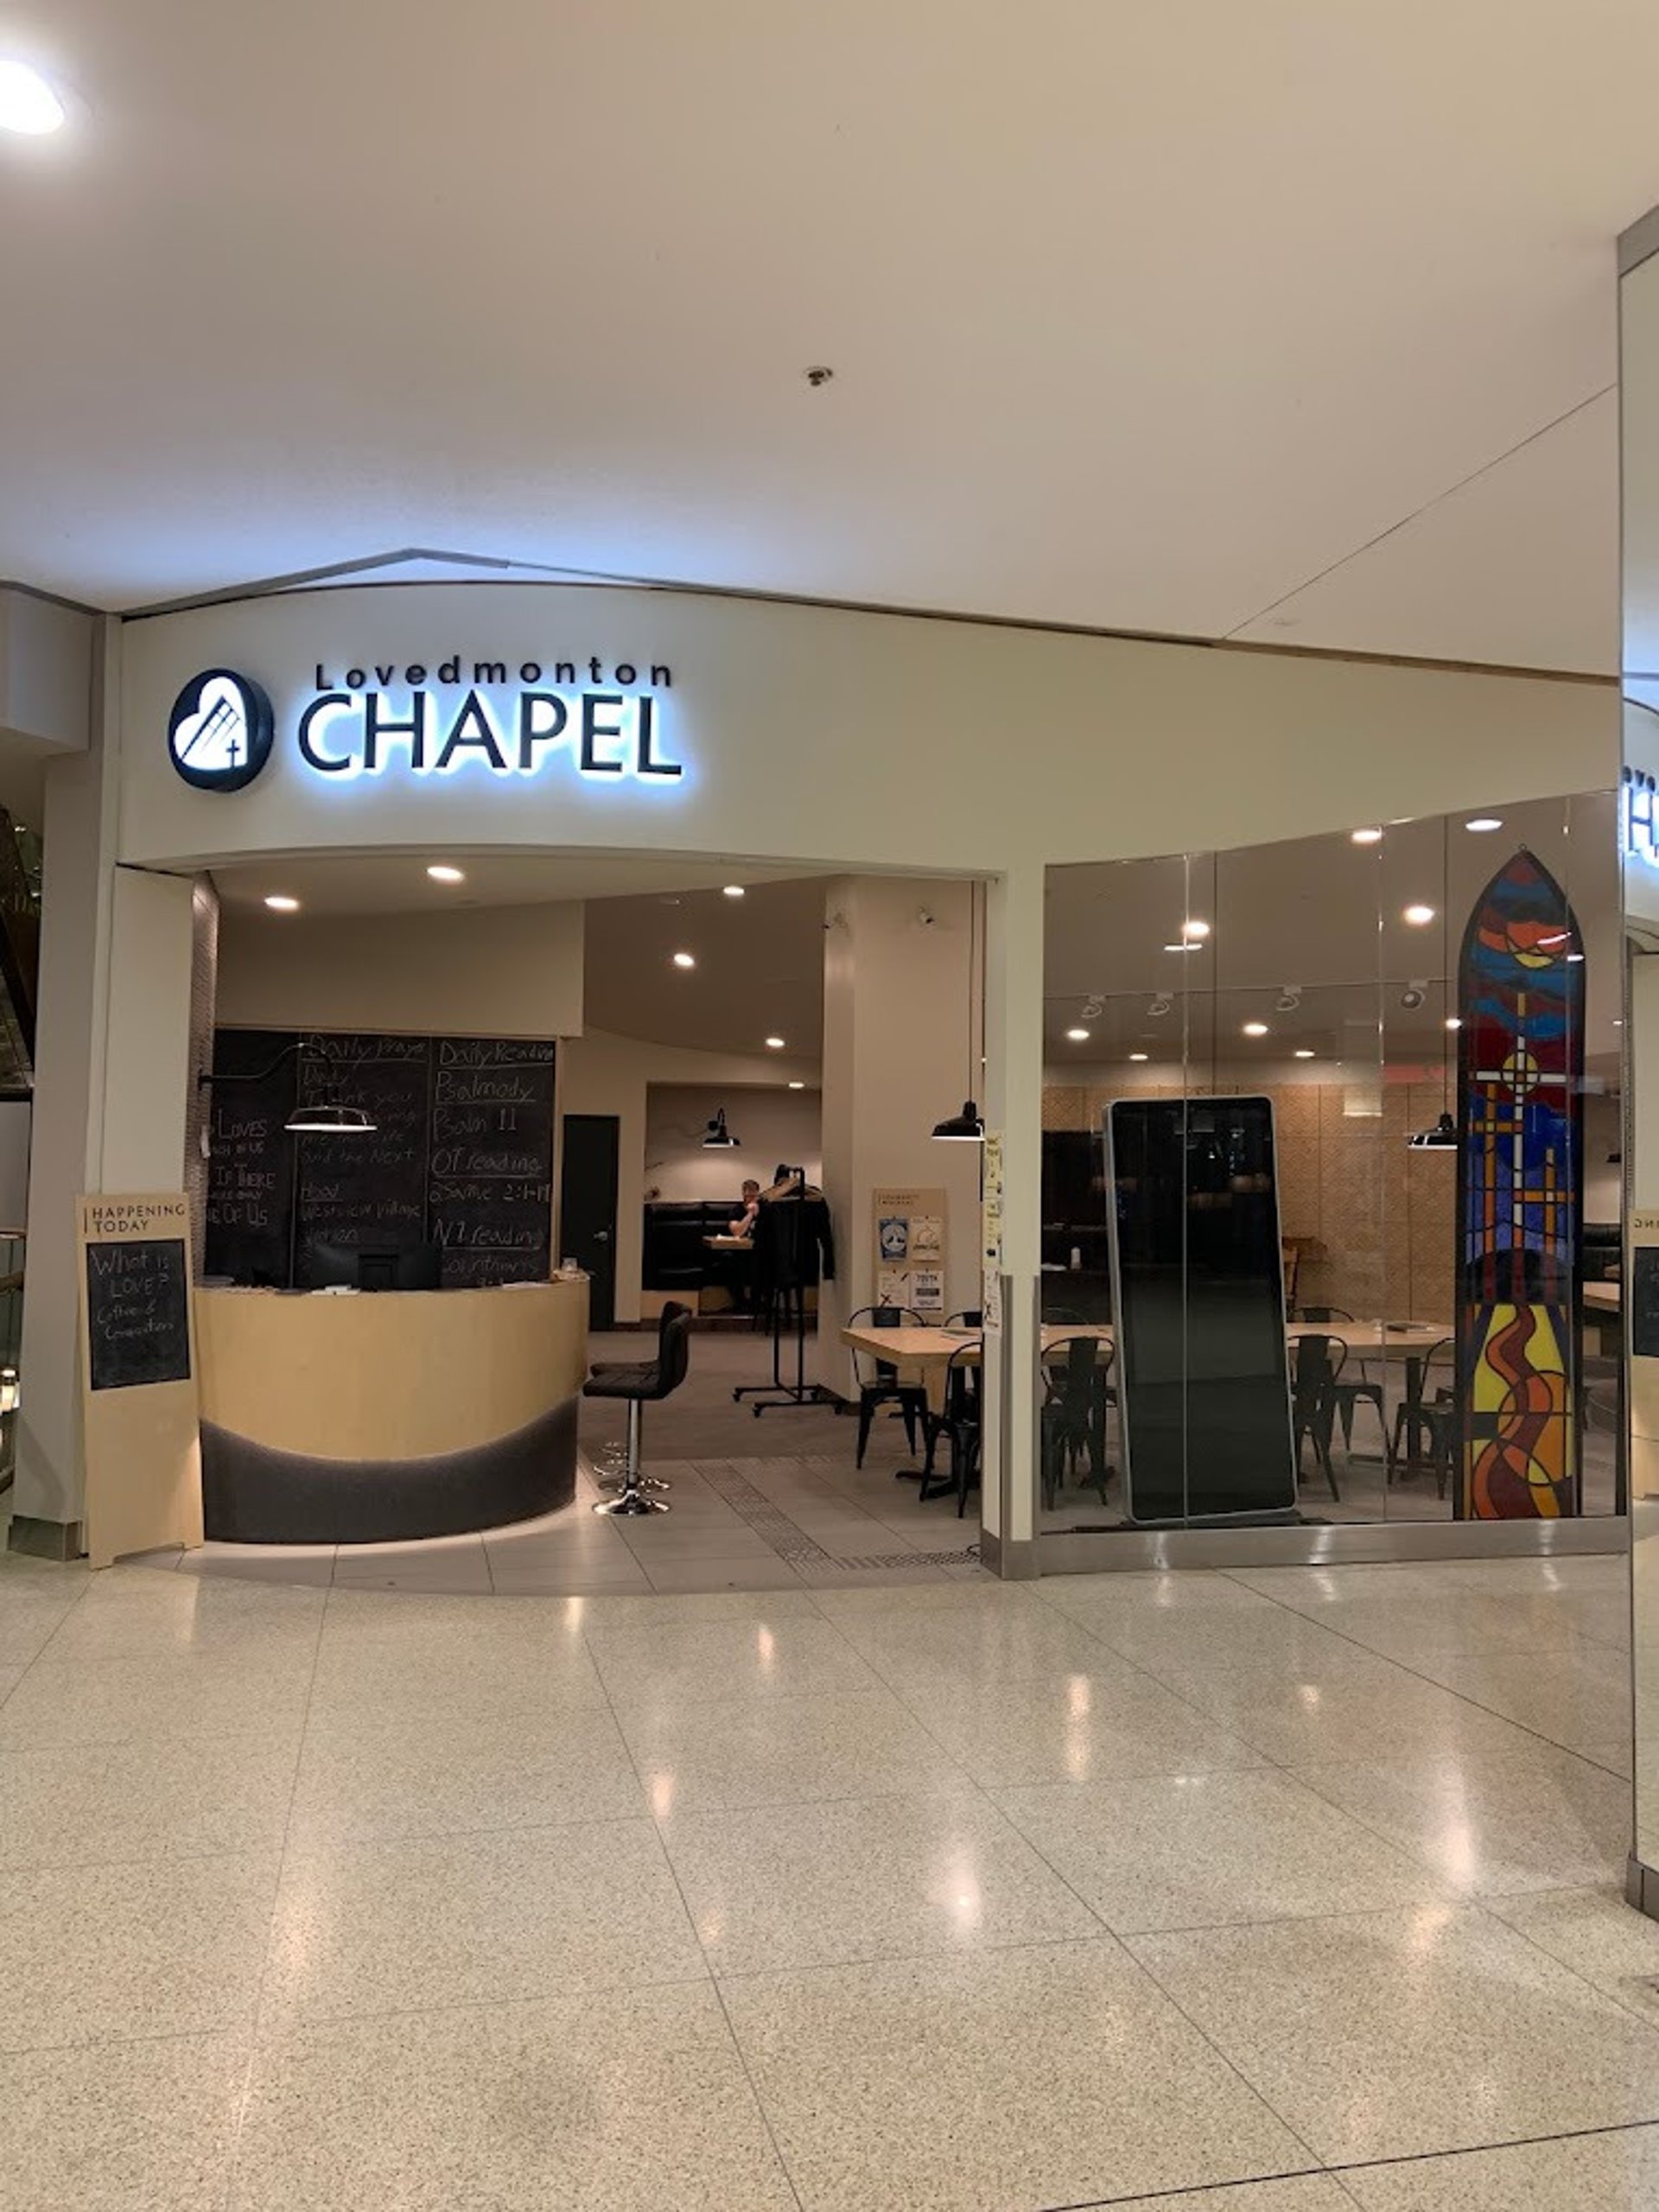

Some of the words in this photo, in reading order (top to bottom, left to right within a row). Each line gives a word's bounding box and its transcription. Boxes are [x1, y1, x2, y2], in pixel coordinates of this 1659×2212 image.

[315, 655, 672, 690] Lovedmonton
[298, 689, 683, 777] CHAPEL
[440, 1040, 493, 1070] Daily
[435, 1071, 535, 1103] Psalmody
[434, 1108, 487, 1141] Psalm
[92, 1203, 185, 1219] HAPPENING
[93, 1218, 149, 1233] TODAY
